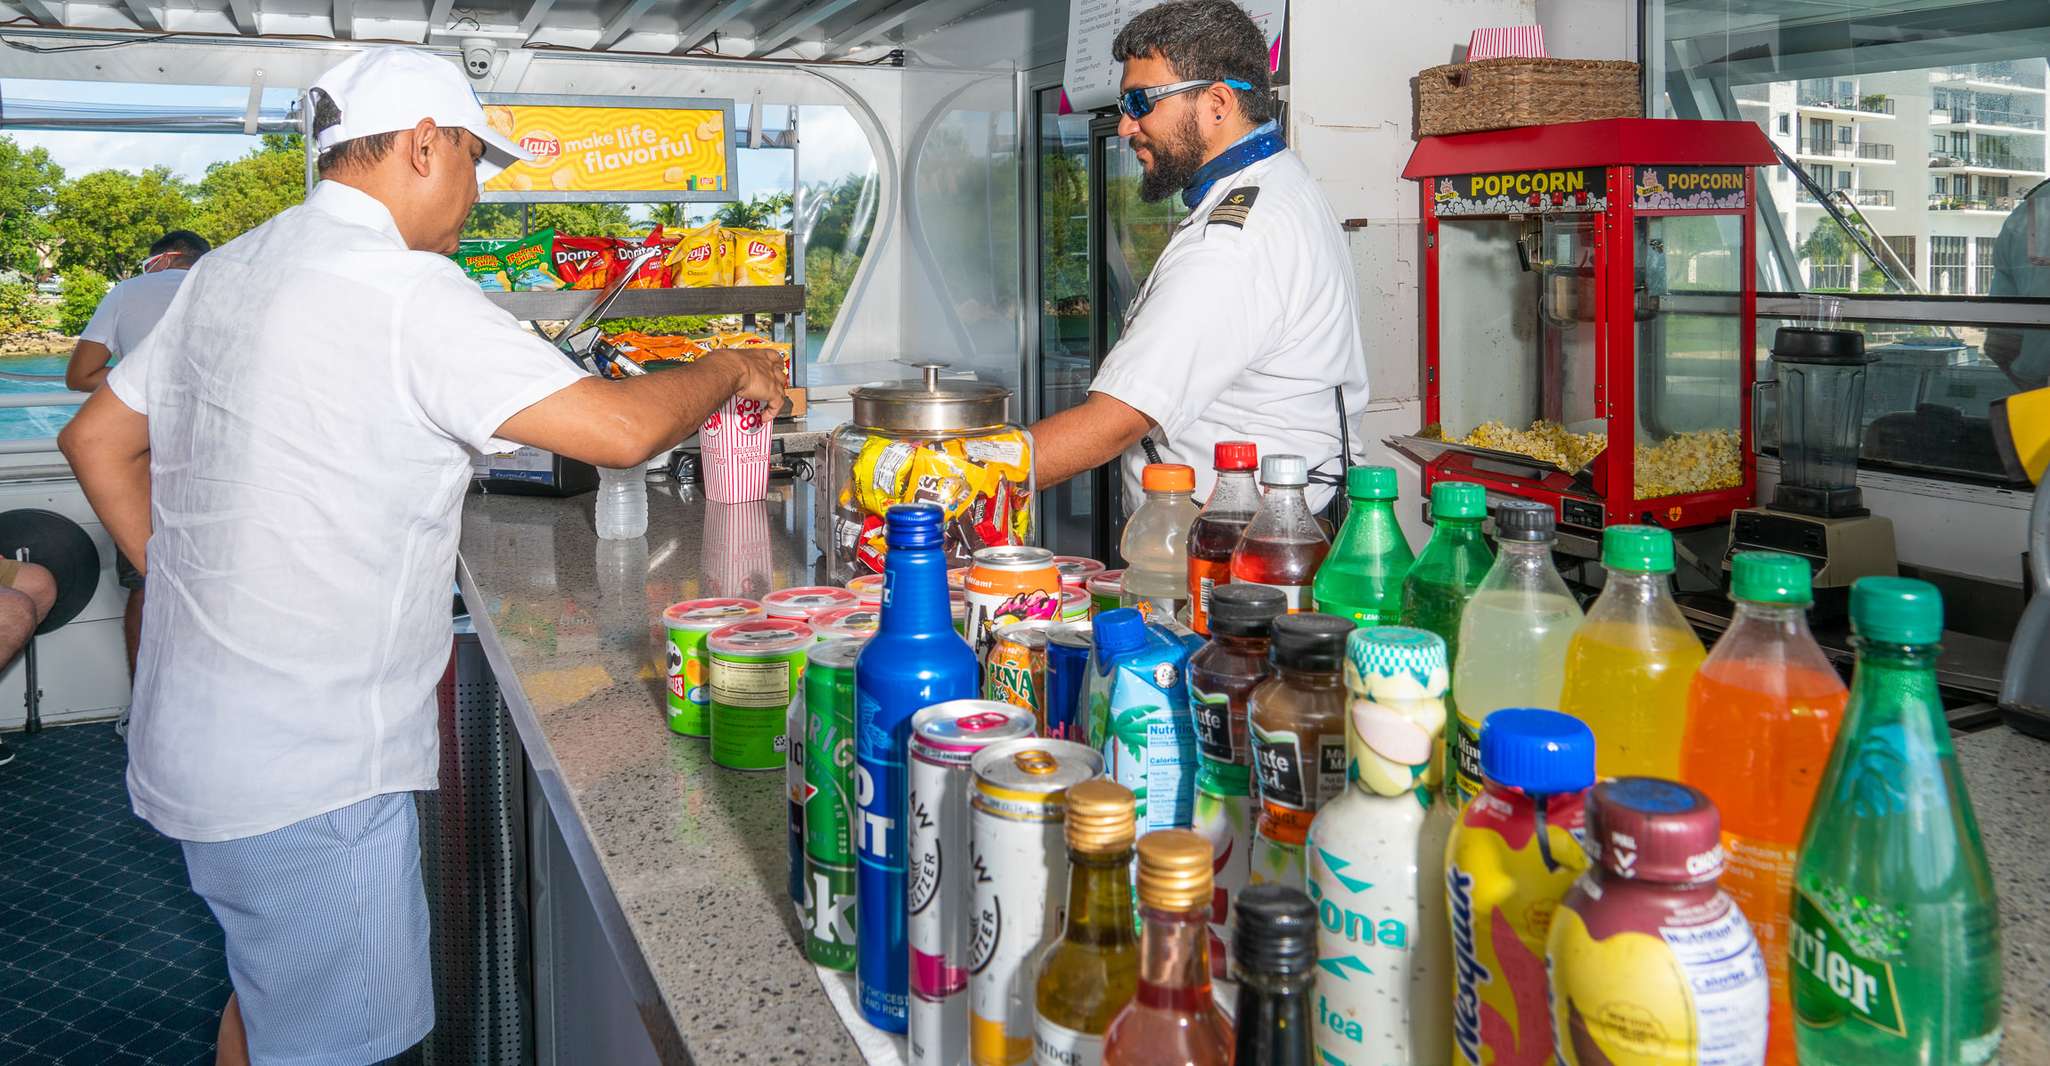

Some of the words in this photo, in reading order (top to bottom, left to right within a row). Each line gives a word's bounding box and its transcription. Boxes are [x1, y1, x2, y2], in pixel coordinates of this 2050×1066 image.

[565, 133, 614, 152] make
[616, 124, 657, 149] life
[584, 133, 693, 173] flavorful
[1471, 171, 1584, 196] POPCORN
[1668, 173, 1744, 190] POPCORN
[1316, 896, 1408, 952] ona
[1448, 866, 1491, 1065] Nesquik
[1318, 994, 1364, 1045] tea
